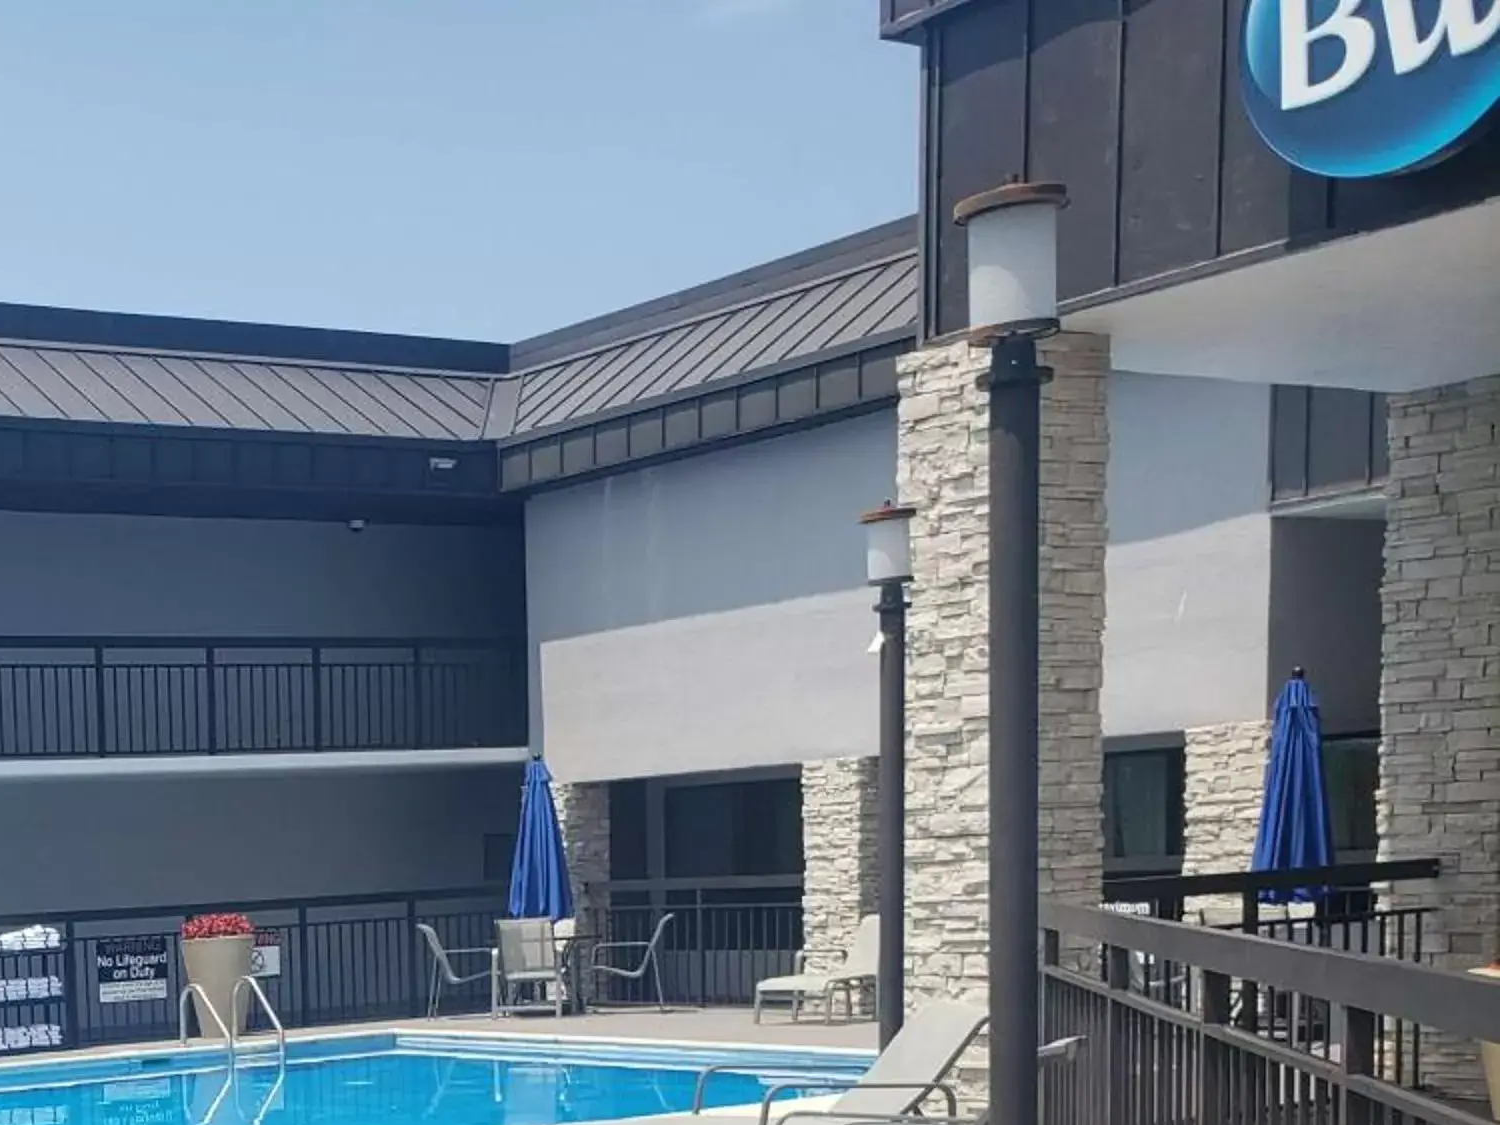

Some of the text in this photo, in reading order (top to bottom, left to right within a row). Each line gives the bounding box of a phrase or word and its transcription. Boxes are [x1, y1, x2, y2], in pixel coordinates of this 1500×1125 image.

[97, 952, 167, 968] No Lifeguard
[113, 965, 155, 980] on Duty
